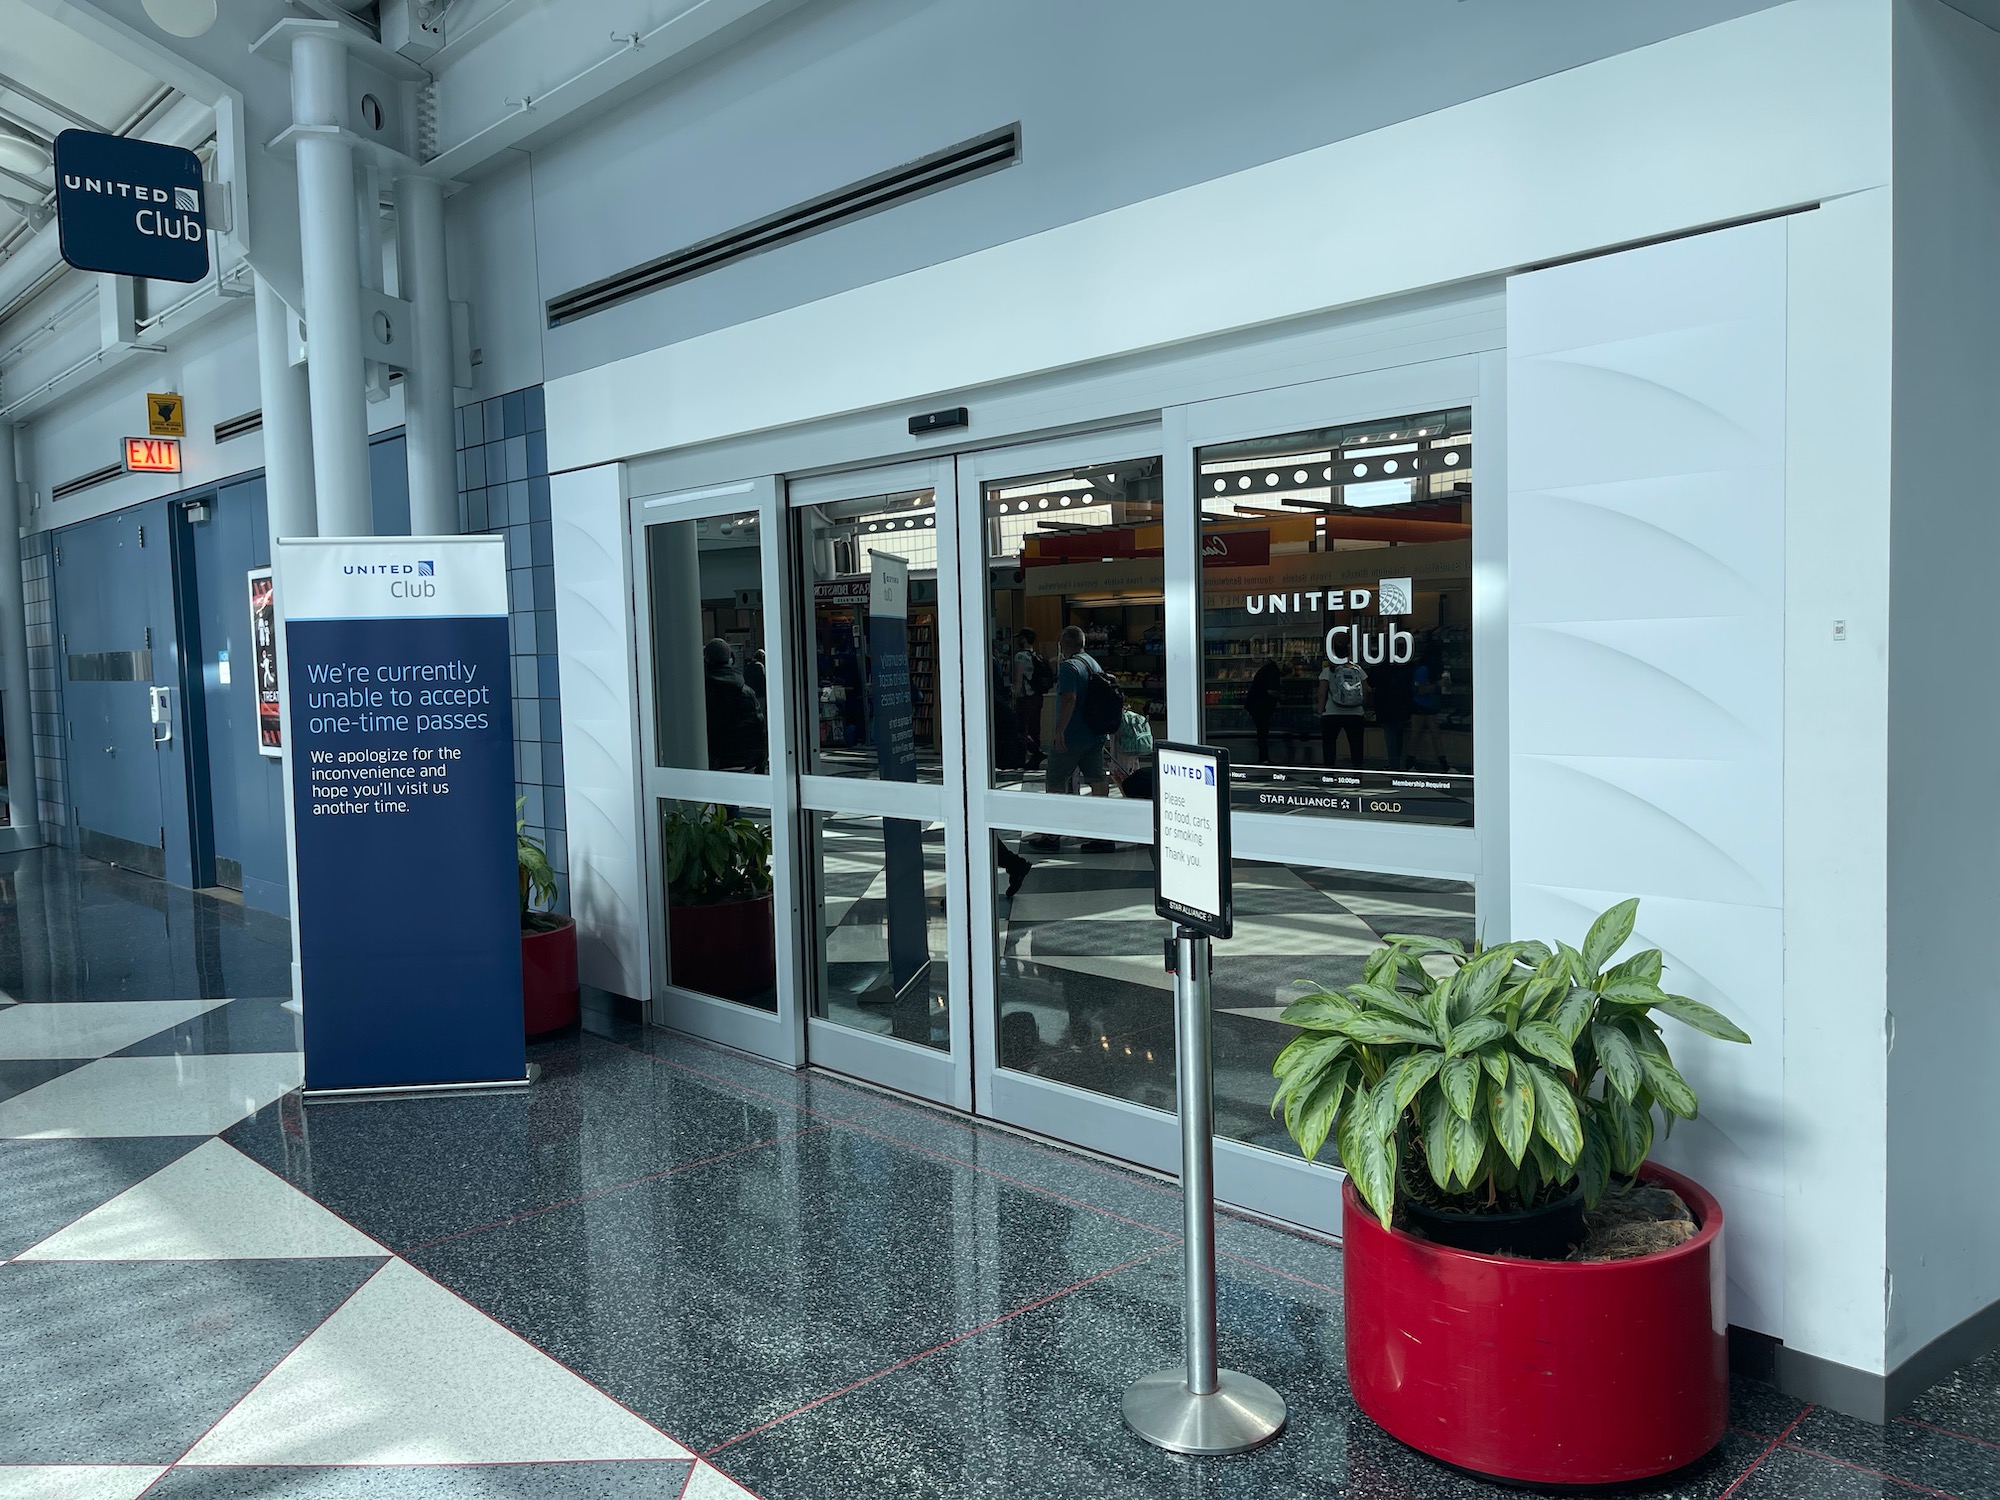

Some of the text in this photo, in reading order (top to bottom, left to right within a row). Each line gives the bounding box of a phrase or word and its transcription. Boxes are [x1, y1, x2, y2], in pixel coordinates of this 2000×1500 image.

[64, 174, 169, 203] UNITED
[135, 209, 202, 242] Club
[129, 440, 174, 464] EXIT
[343, 564, 413, 575] UNITED
[390, 580, 436, 598] Club
[1246, 588, 1372, 615] UNITED
[1325, 622, 1415, 665] Club
[307, 660, 477, 684] We're currently
[308, 685, 490, 709] unable to accept
[309, 712, 489, 734] one-time passes
[310, 747, 462, 764] We apologize for the
[311, 764, 447, 780] inconvenience and
[1163, 763, 1203, 780] UNITED
[1272, 773, 1286, 781] Daily
[1392, 780, 1425, 788] Membership
[1425, 781, 1451, 789] Required
[312, 781, 449, 799] hope you'll visit us
[1164, 792, 1186, 807] Please
[312, 800, 410, 815] another time.
[1259, 794, 1401, 812] STAR ALLIANCE GOLD
[1164, 809, 1212, 831] no food, carts,
[1164, 826, 1204, 846] or smoking.
[1165, 846, 1201, 868] Thank you.
[1169, 901, 1208, 921] STAR ALLIANCE
